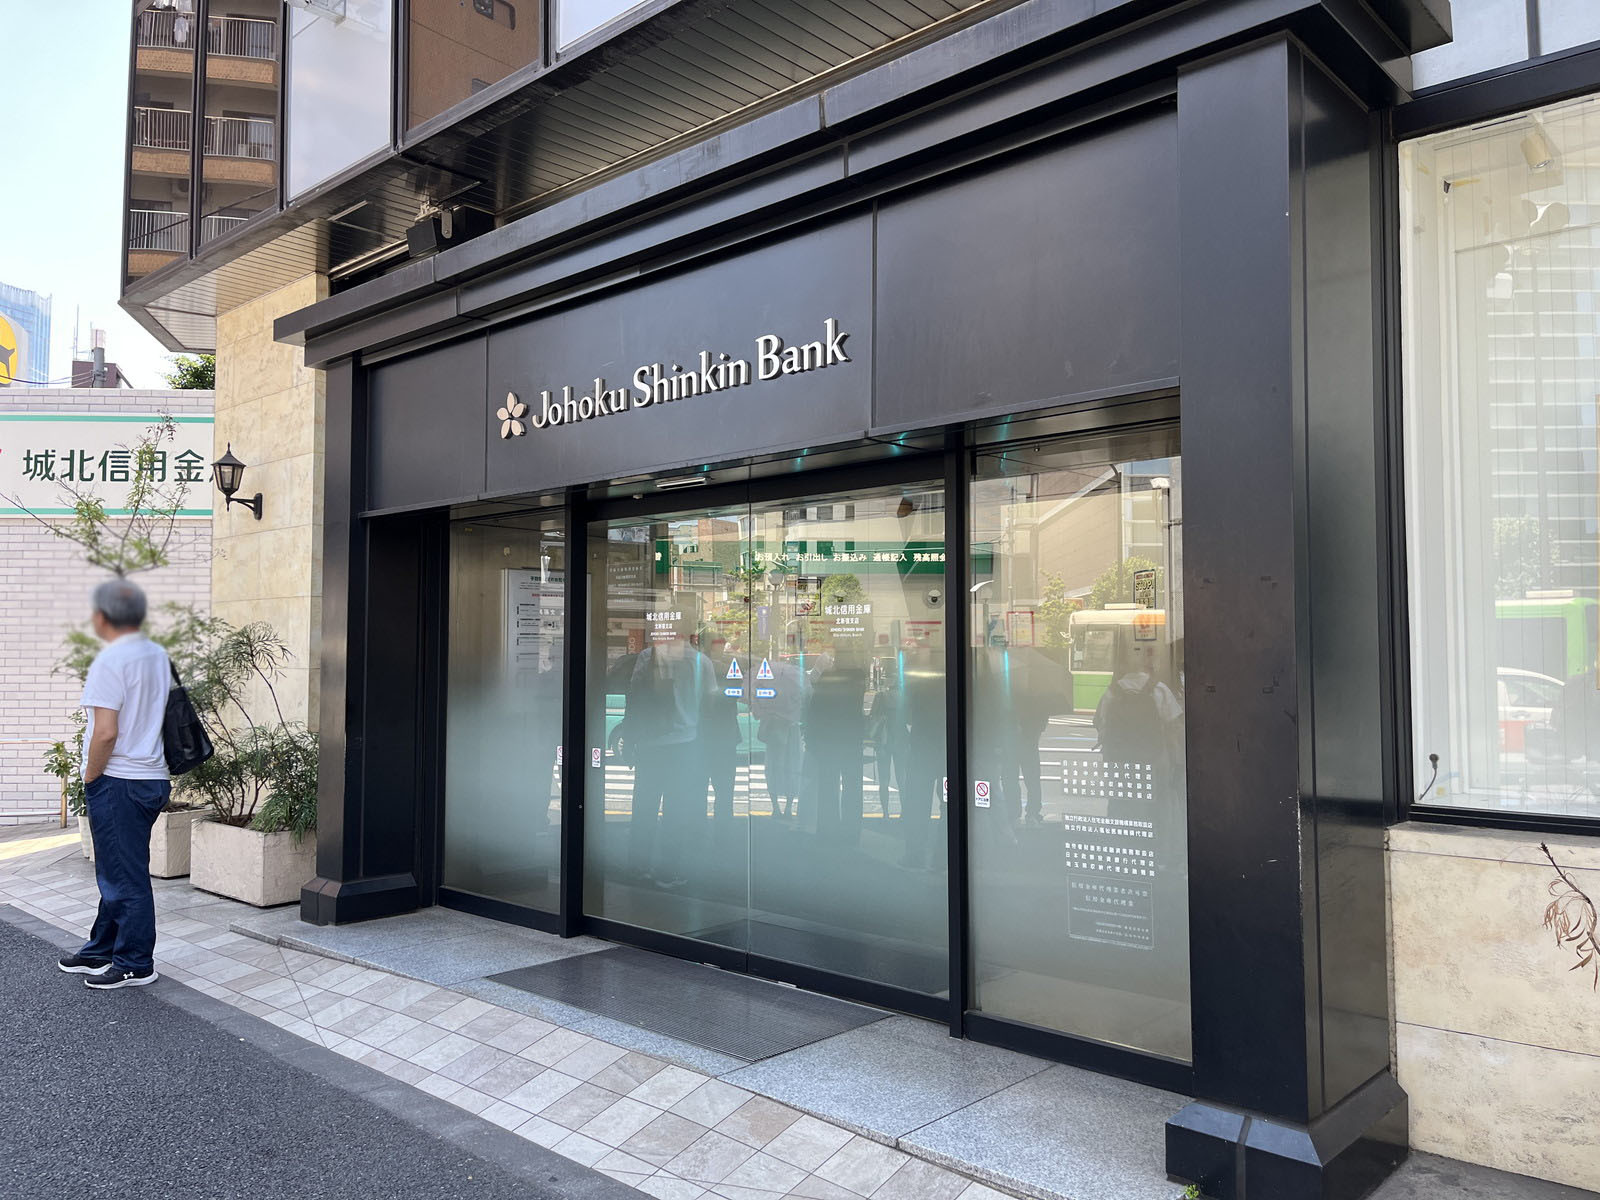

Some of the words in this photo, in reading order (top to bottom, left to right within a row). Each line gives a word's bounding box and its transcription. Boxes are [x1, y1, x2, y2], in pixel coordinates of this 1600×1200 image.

[532, 376, 629, 428] Johoku
[633, 350, 751, 407] Shinkin
[755, 317, 852, 380] Bank
[22, 448, 214, 483] 城北信用金
[796, 552, 829, 562] お引出し
[833, 552, 867, 562] お振込み
[872, 552, 908, 562] 通帳記入
[824, 604, 872, 615] 城北信用金庫
[646, 611, 682, 621] 城北信用金庫
